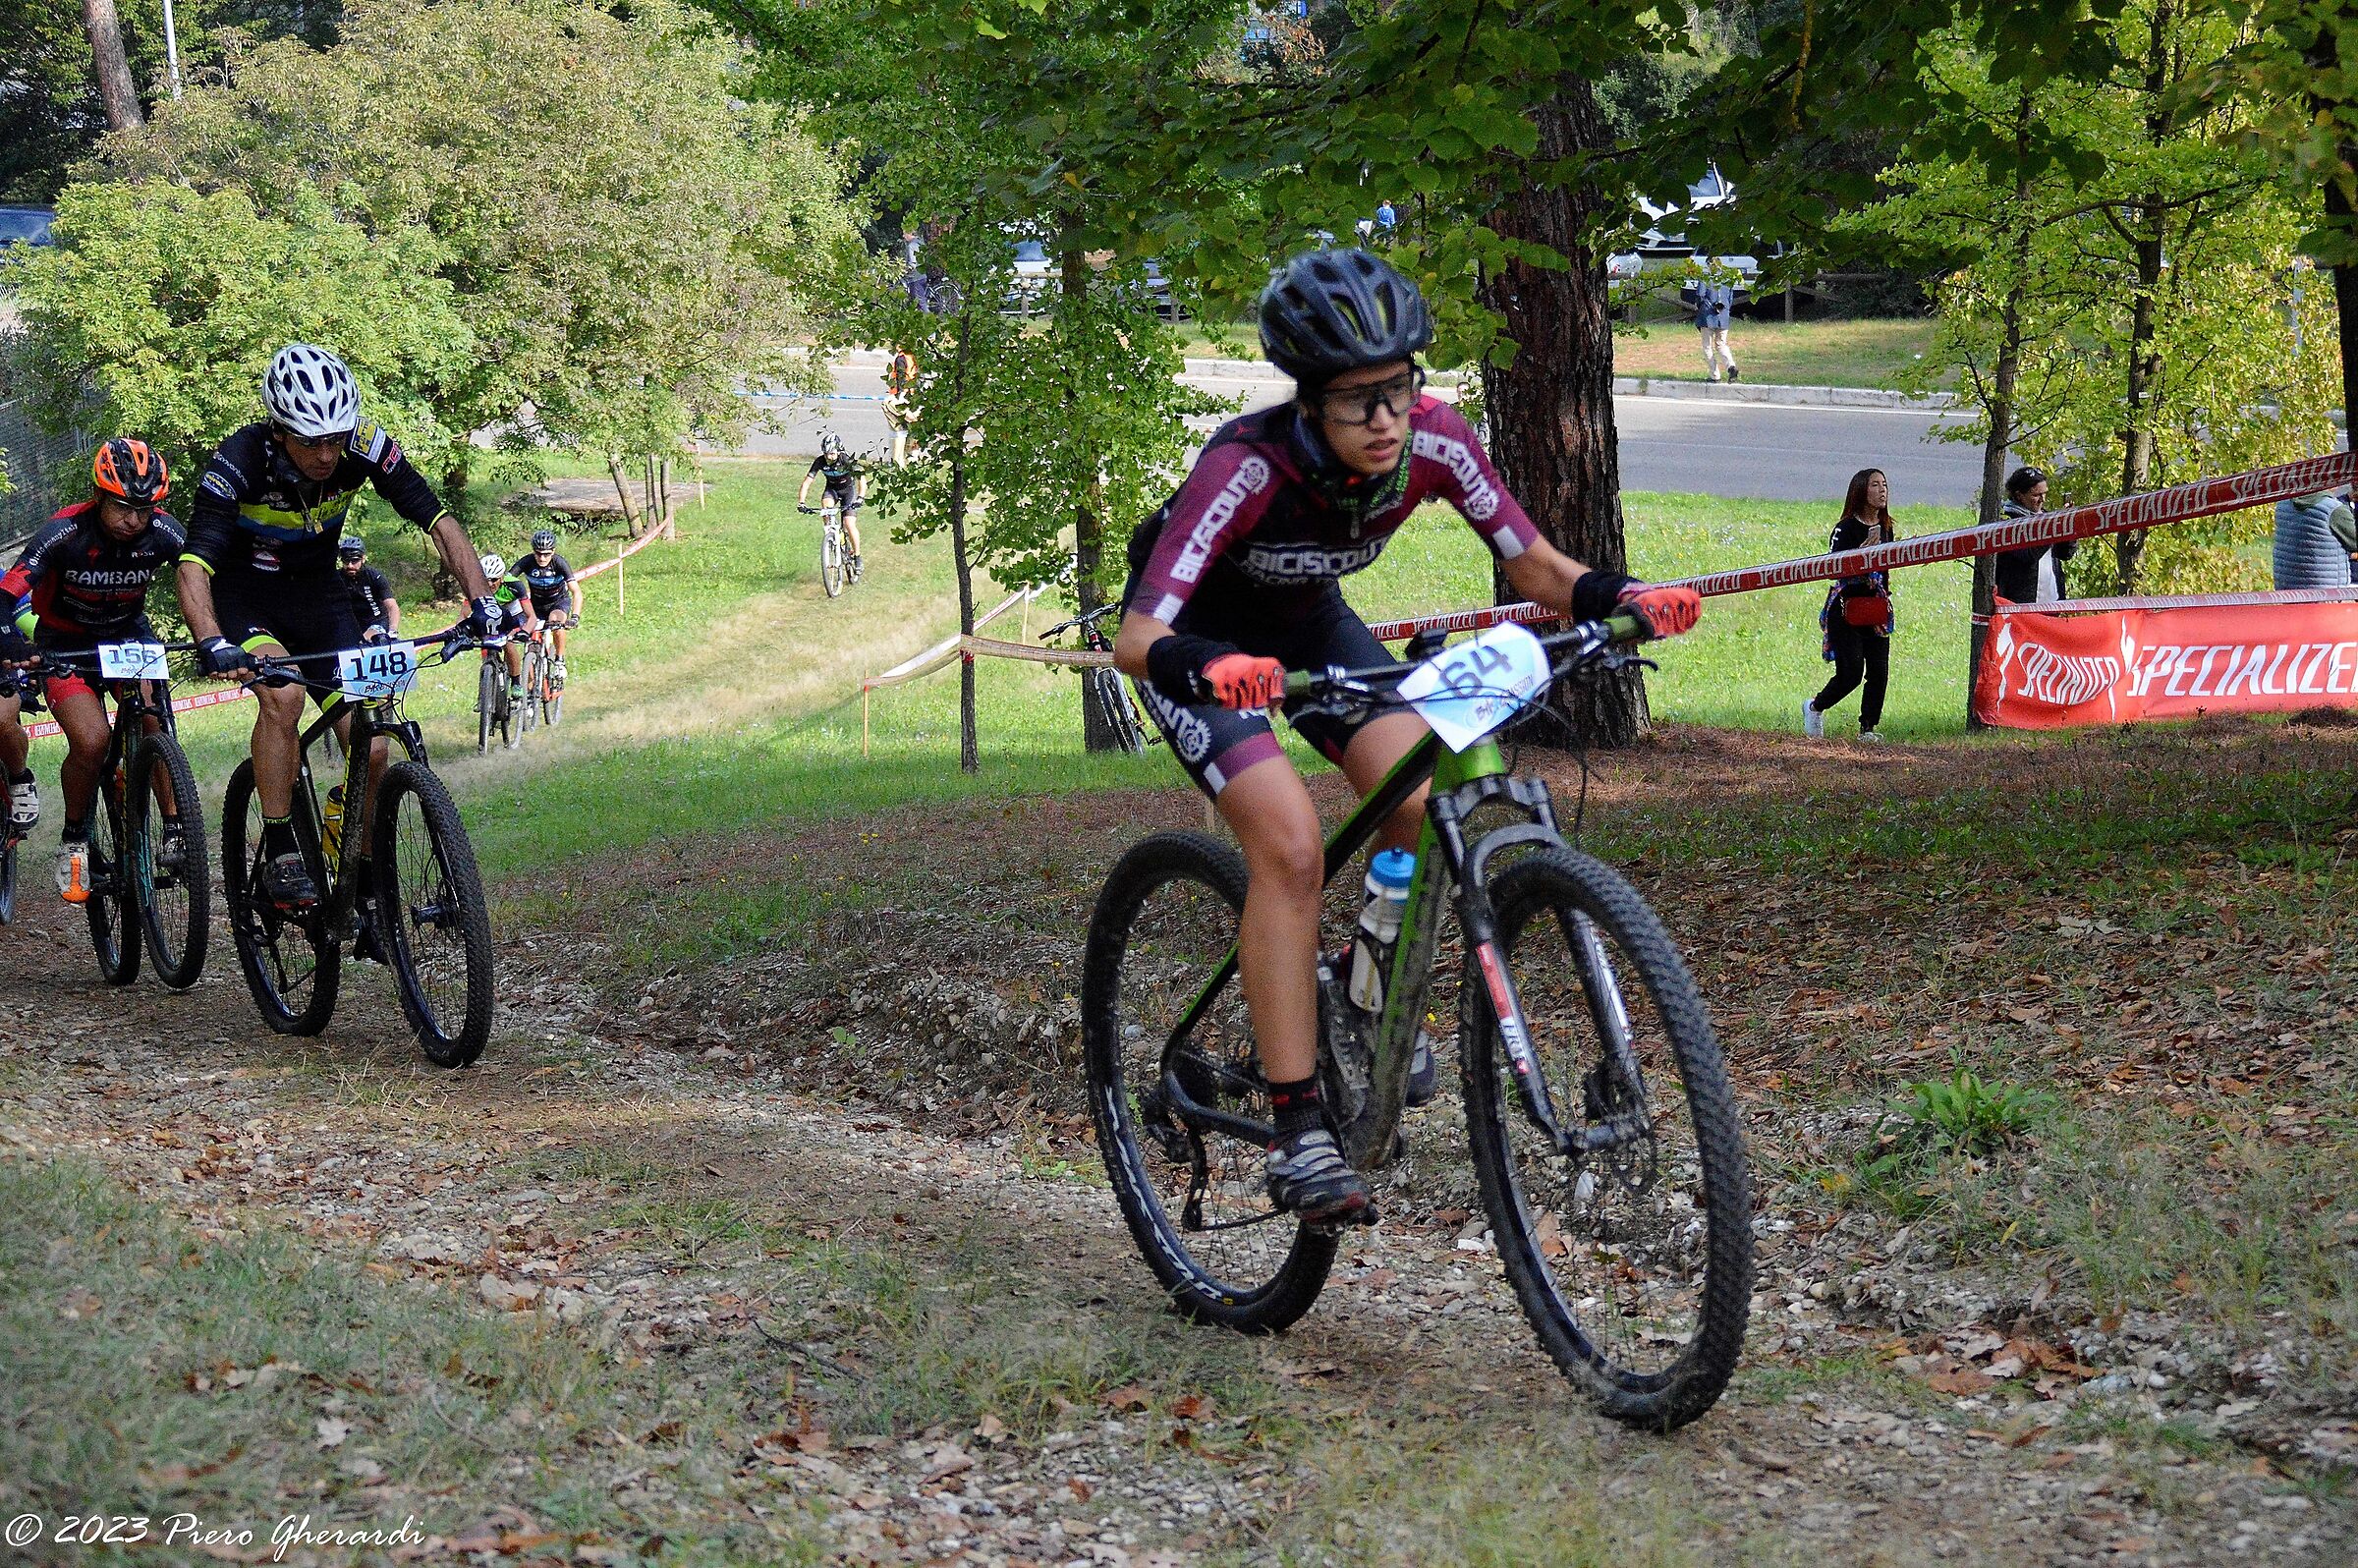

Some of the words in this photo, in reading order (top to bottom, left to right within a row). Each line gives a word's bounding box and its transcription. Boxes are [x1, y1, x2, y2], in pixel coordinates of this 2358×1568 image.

[1859, 533, 1954, 570] SPECIALIZED
[1972, 510, 2076, 551] SPECIALIZED
[2094, 482, 2210, 531] SPECIALIZED
[108, 648, 158, 665] 156
[350, 650, 408, 682] 148
[1438, 644, 1513, 700] 64
